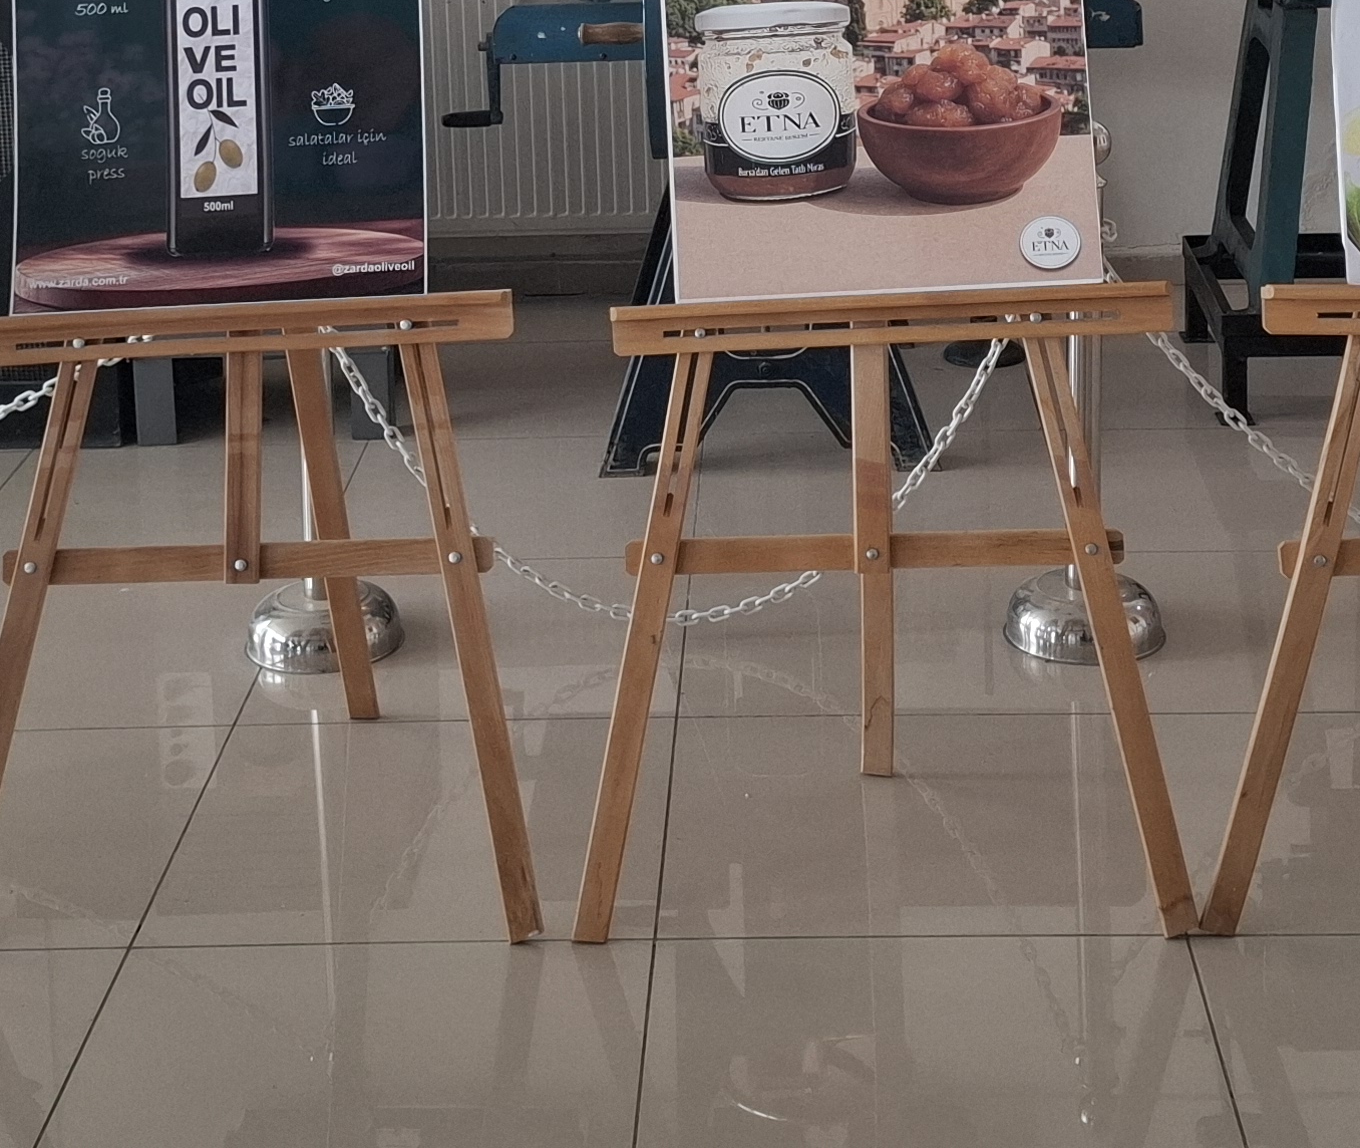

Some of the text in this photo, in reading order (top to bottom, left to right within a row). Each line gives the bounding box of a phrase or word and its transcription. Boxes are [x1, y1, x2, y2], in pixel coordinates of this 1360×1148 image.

[75, 2, 129, 16] 500 ml
[182, 4, 240, 38] OLI
[183, 44, 238, 74] VE
[186, 77, 248, 110] OIL
[739, 111, 821, 134] ETNA
[288, 128, 387, 147] salatalar için
[322, 151, 358, 165] ideal
[88, 168, 125, 185] press
[203, 201, 234, 212] 500ml
